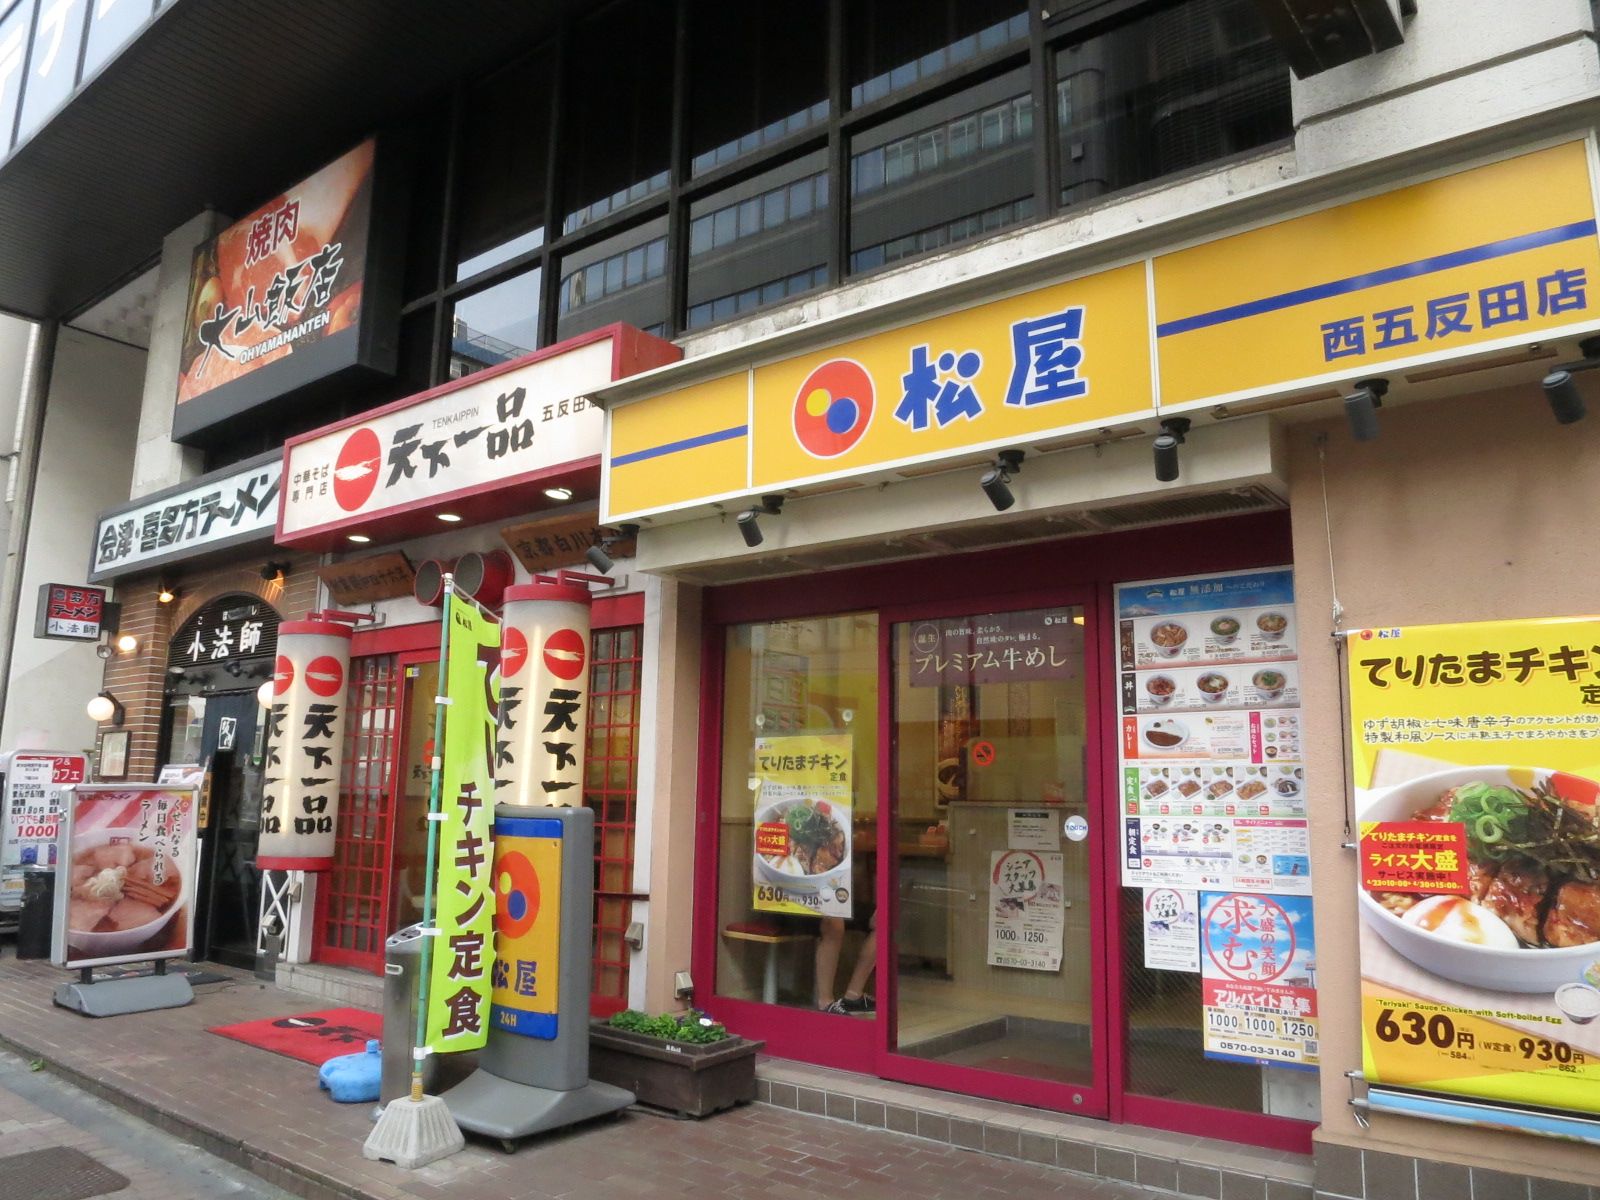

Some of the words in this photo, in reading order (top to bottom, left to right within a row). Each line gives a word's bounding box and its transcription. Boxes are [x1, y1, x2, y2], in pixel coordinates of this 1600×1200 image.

[245, 199, 300, 268] 焼肉
[197, 243, 344, 378] 大山飯店
[1320, 267, 1587, 362] 西五反田店
[240, 311, 330, 365] OHYAMAHANTEN
[893, 305, 1088, 432] 松屋
[432, 405, 479, 430] TENKAIPPIN
[386, 386, 536, 488] 天下一品
[52, 604, 98, 618] ラーメン
[49, 621, 97, 635] 小法師
[186, 621, 263, 661] 小法師
[1377, 628, 1401, 639] 松屋
[915, 646, 1067, 674] プレミアム牛めし
[541, 688, 582, 807] 天下一
[294, 703, 340, 835] 天下一品
[759, 754, 848, 771] てりたまチキン
[830, 772, 847, 781] 定食
[18, 825, 58, 840] 1000
[139, 800, 151, 842] ラーメン
[171, 800, 181, 857] くせになる
[153, 800, 168, 884] 毎日食べられる
[1006, 859, 1032, 871] シニア
[1369, 849, 1458, 871] ライス大盛
[1004, 870, 1037, 882] スタッフ
[442, 781, 484, 1037] チキン定食
[1260, 903, 1276, 975] 大盛の笑顔
[1213, 989, 1311, 1013] アルバイト募集
[1414, 1003, 1438, 1012] Sauce
[1441, 1005, 1473, 1015] Chicken
[1475, 1008, 1493, 1017] with
[1496, 1010, 1543, 1022] Soft-boiled
[500, 1011, 517, 1027] 24H
[1220, 1041, 1296, 1058] 0570-03-3140
